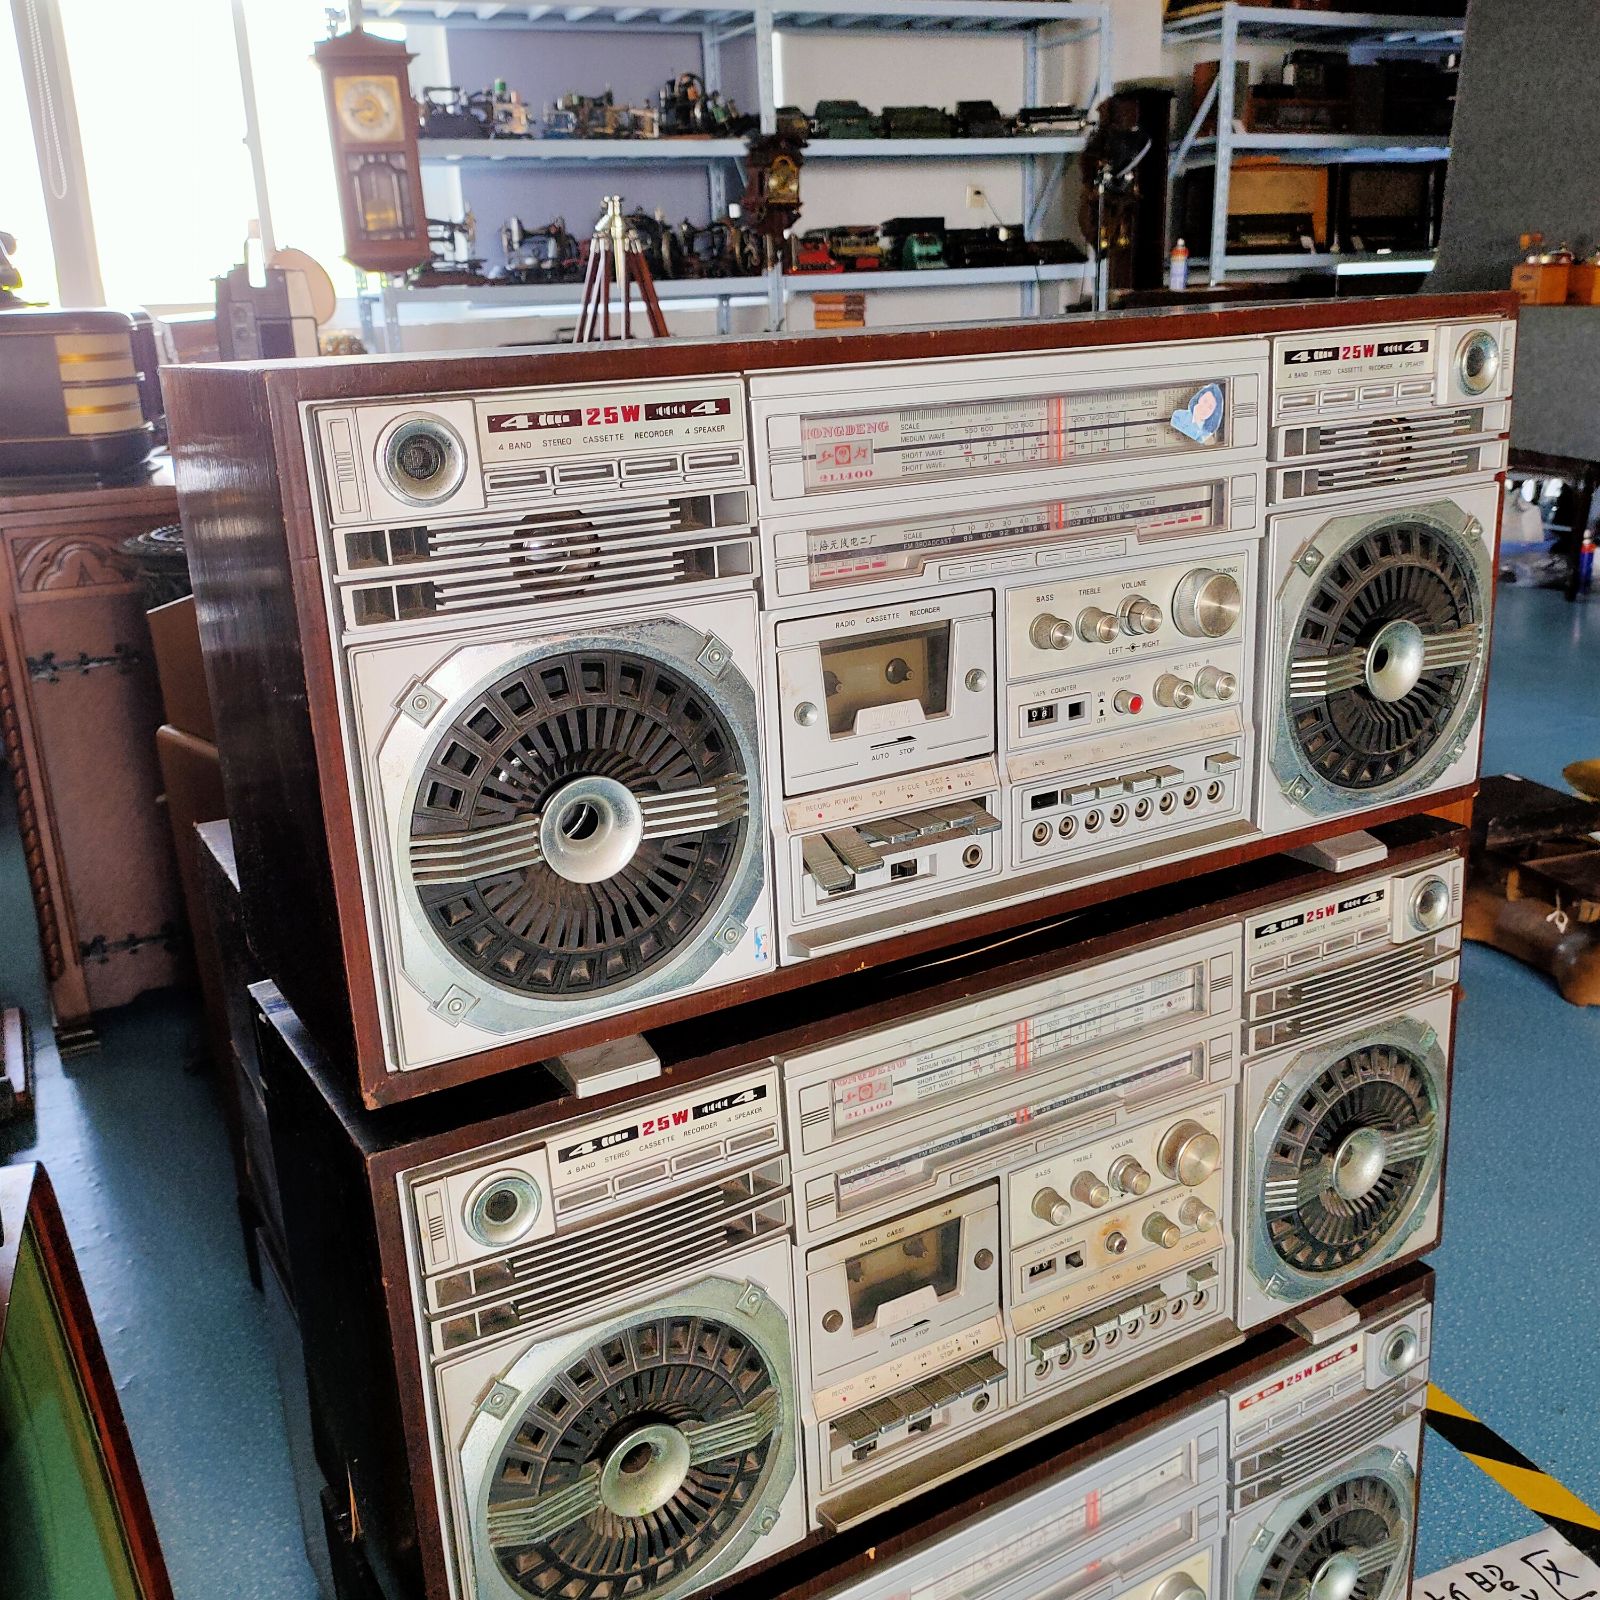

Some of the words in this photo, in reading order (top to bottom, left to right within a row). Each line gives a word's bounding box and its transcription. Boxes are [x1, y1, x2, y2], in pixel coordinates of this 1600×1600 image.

[1291, 351, 1311, 362] 4
[1342, 345, 1375, 360] 25W
[1404, 342, 1423, 352] 4
[501, 415, 533, 429] 4
[586, 404, 640, 426] 25W
[690, 401, 719, 414] 4
[508, 441, 532, 450] BAND
[542, 438, 572, 447] STEREO
[582, 433, 624, 444] CASSETTE
[634, 429, 674, 440] RECORDER
[693, 424, 725, 434] SPEAKER
[901, 435, 926, 443] MEDIUM
[902, 464, 923, 472] SHORT
[904, 532, 922, 540] SCALE
[915, 538, 951, 549] BROADCAST
[1121, 580, 1146, 589] VOLUME
[1036, 593, 1054, 602] BASS
[1079, 586, 1101, 596] TREBLE
[835, 619, 856, 628] RADIO
[865, 613, 900, 624] CASSETTE
[909, 606, 941, 616] RECORDER
[1108, 645, 1123, 655] LEFT
[1142, 639, 1160, 649] RIGHT
[1112, 674, 1131, 683] POWER
[1050, 684, 1077, 694] COUNTER
[871, 752, 890, 761] AUTO
[899, 746, 915, 755] STOP
[928, 786, 944, 794] STOP
[805, 802, 831, 812] RECORD
[872, 790, 886, 798] PLAY
[1260, 923, 1280, 935] 4
[1306, 904, 1336, 923] 25W
[1361, 892, 1380, 903] 4
[917, 1053, 933, 1062] SCALE
[917, 1061, 939, 1073] MEDIUM
[917, 1075, 936, 1086] SHORT
[917, 1085, 936, 1096] SHORT
[569, 1141, 597, 1157] 4
[642, 1109, 689, 1136] 25W
[731, 1089, 757, 1104] 4
[575, 1161, 596, 1173] BAND
[605, 1150, 630, 1163] STEREO
[639, 1135, 675, 1152] CASSETTE
[683, 1121, 718, 1136] RECORDER
[734, 1106, 763, 1121] SPEAKER
[1110, 1138, 1134, 1150] VOLUME
[929, 1138, 962, 1155] BROADCAST
[1035, 1168, 1052, 1179] BASS
[1073, 1153, 1093, 1165] TREBLE
[859, 1237, 878, 1247] RADIO
[1033, 1305, 1047, 1315] TAPE
[890, 1336, 907, 1348] AUTO
[915, 1327, 930, 1338] STOP
[1286, 1365, 1313, 1387] 25W
